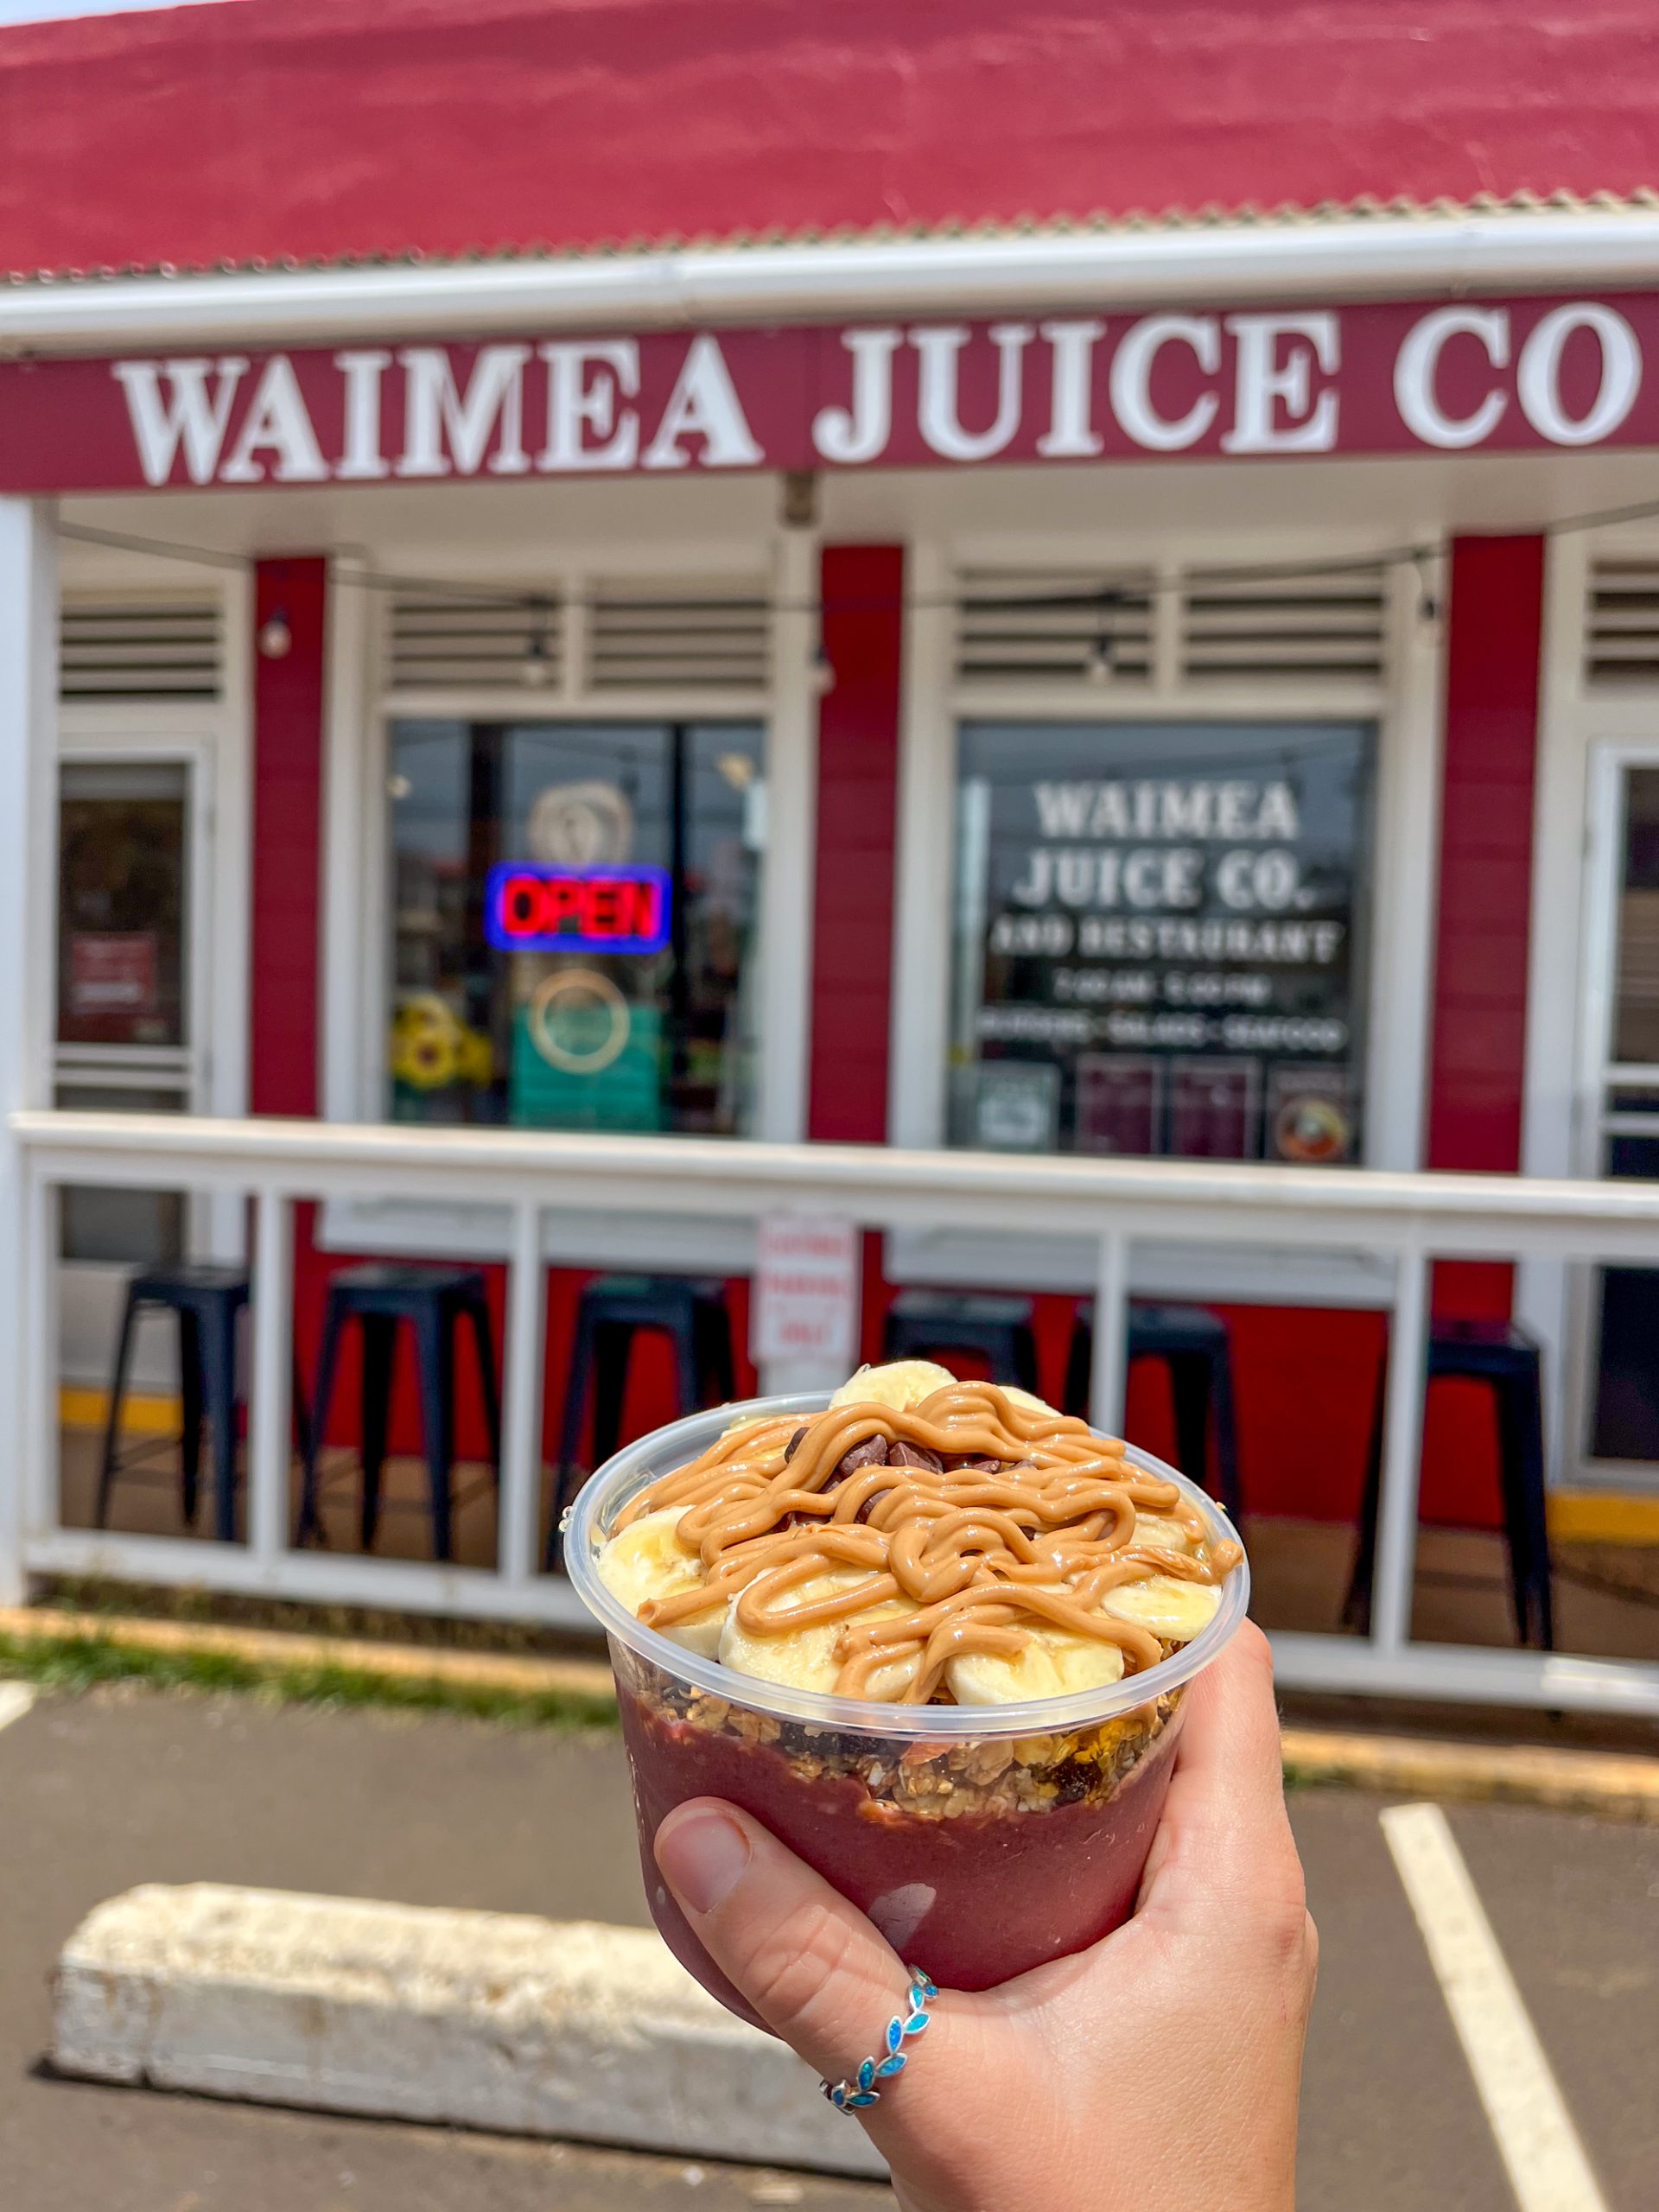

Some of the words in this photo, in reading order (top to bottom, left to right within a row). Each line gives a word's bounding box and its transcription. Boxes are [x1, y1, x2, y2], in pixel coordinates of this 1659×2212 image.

[111, 332, 766, 486] WAIMEA
[810, 308, 1341, 463] JUICE
[1392, 302, 1643, 450] CO
[1036, 780, 1297, 839] WAIMEA
[504, 874, 660, 939] OPEN
[1013, 846, 1205, 907] JUICE
[1216, 849, 1315, 910] CO.
[991, 912, 1074, 957] AND
[1078, 916, 1344, 963] RESTAURANT
